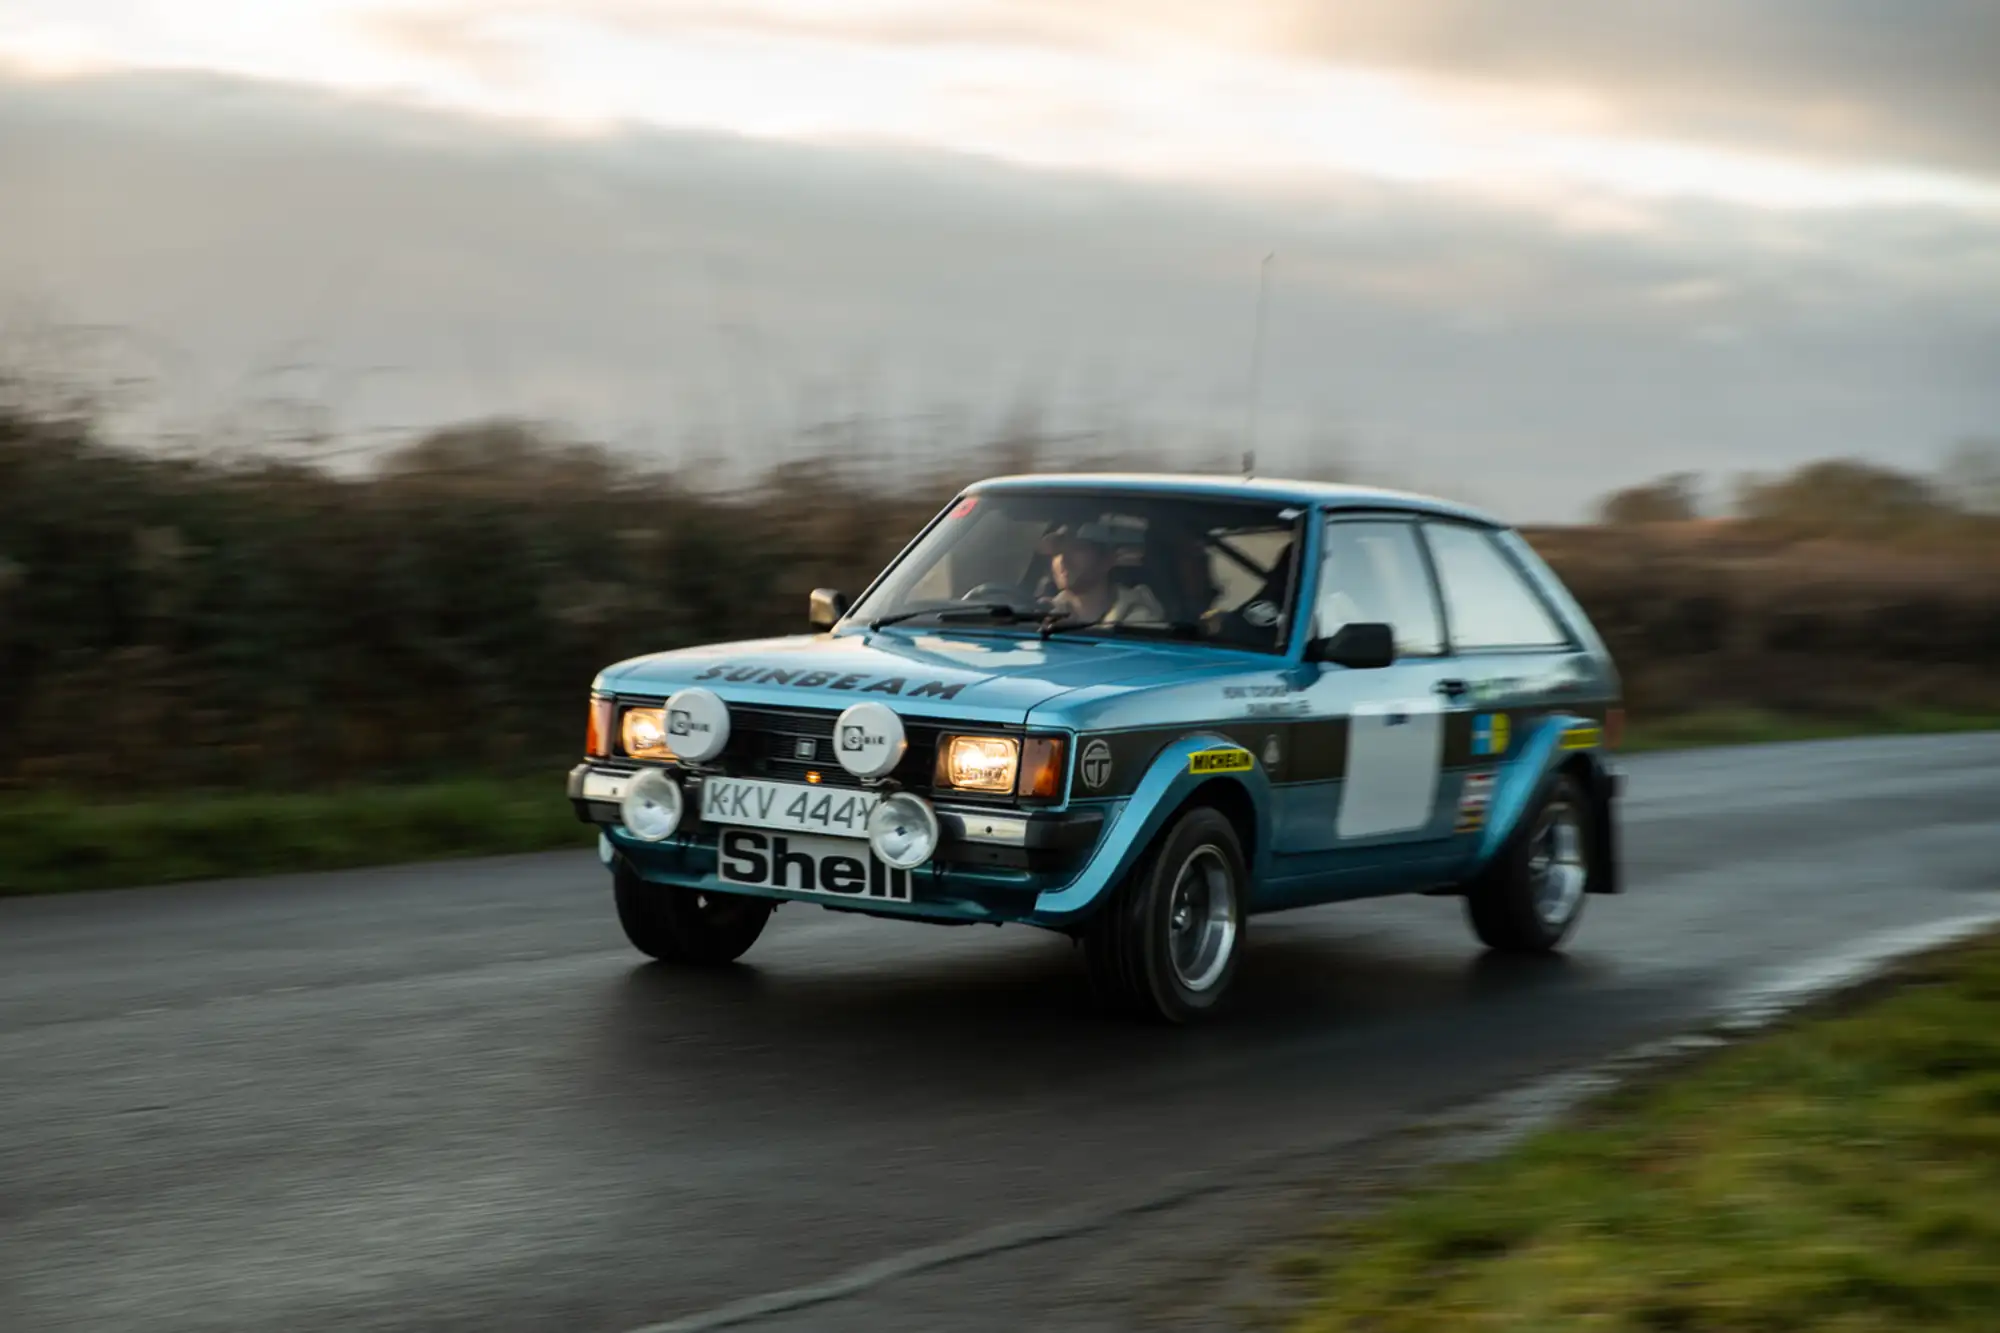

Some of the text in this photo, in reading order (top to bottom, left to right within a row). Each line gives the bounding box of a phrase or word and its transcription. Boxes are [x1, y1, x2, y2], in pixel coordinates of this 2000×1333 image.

[693, 664, 967, 700] SUNBEAM
[1193, 750, 1253, 771] MICHELIN
[707, 781, 880, 831] KKV 444Y
